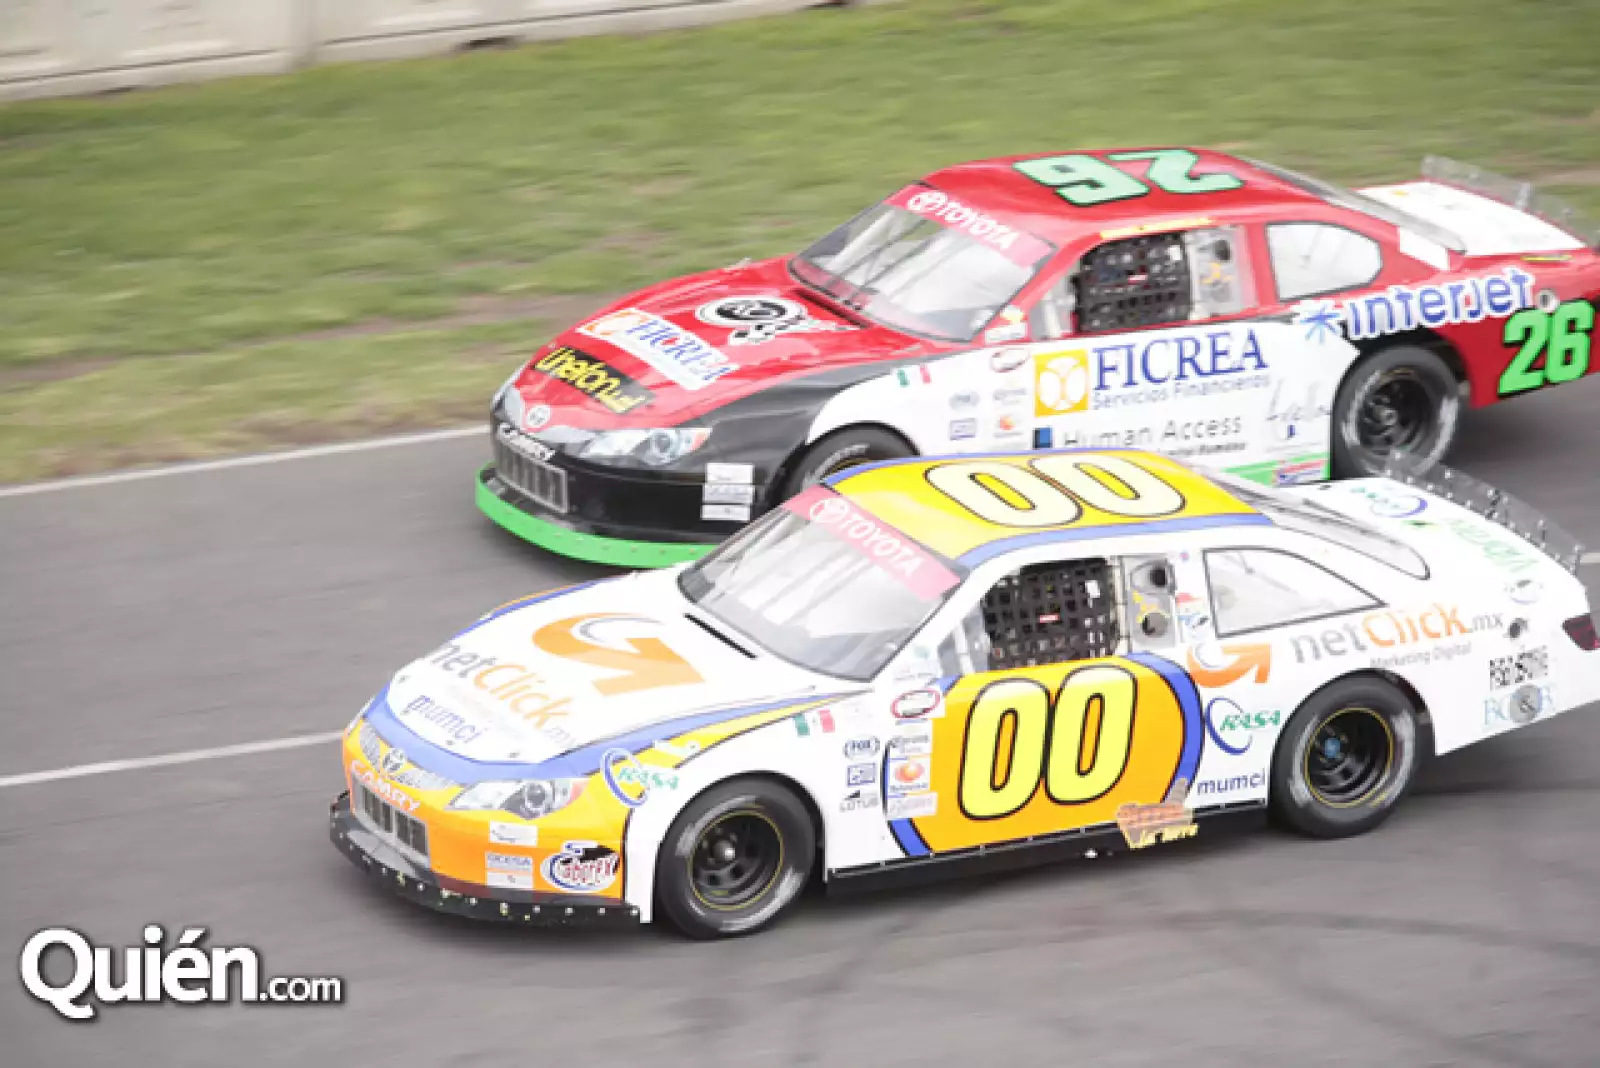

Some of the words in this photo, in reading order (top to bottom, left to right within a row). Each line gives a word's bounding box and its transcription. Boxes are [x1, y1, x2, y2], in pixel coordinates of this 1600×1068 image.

[935, 201, 1019, 250] TOYOTA
[1091, 327, 1269, 391] FICREA
[1497, 299, 1595, 398] 26
[1063, 424, 1151, 450] Human
[1161, 415, 1242, 442] Access
[925, 453, 1186, 528] 00
[839, 512, 925, 578] TOYOTA
[960, 664, 1138, 820] 00
[350, 758, 421, 812] CAMRY
